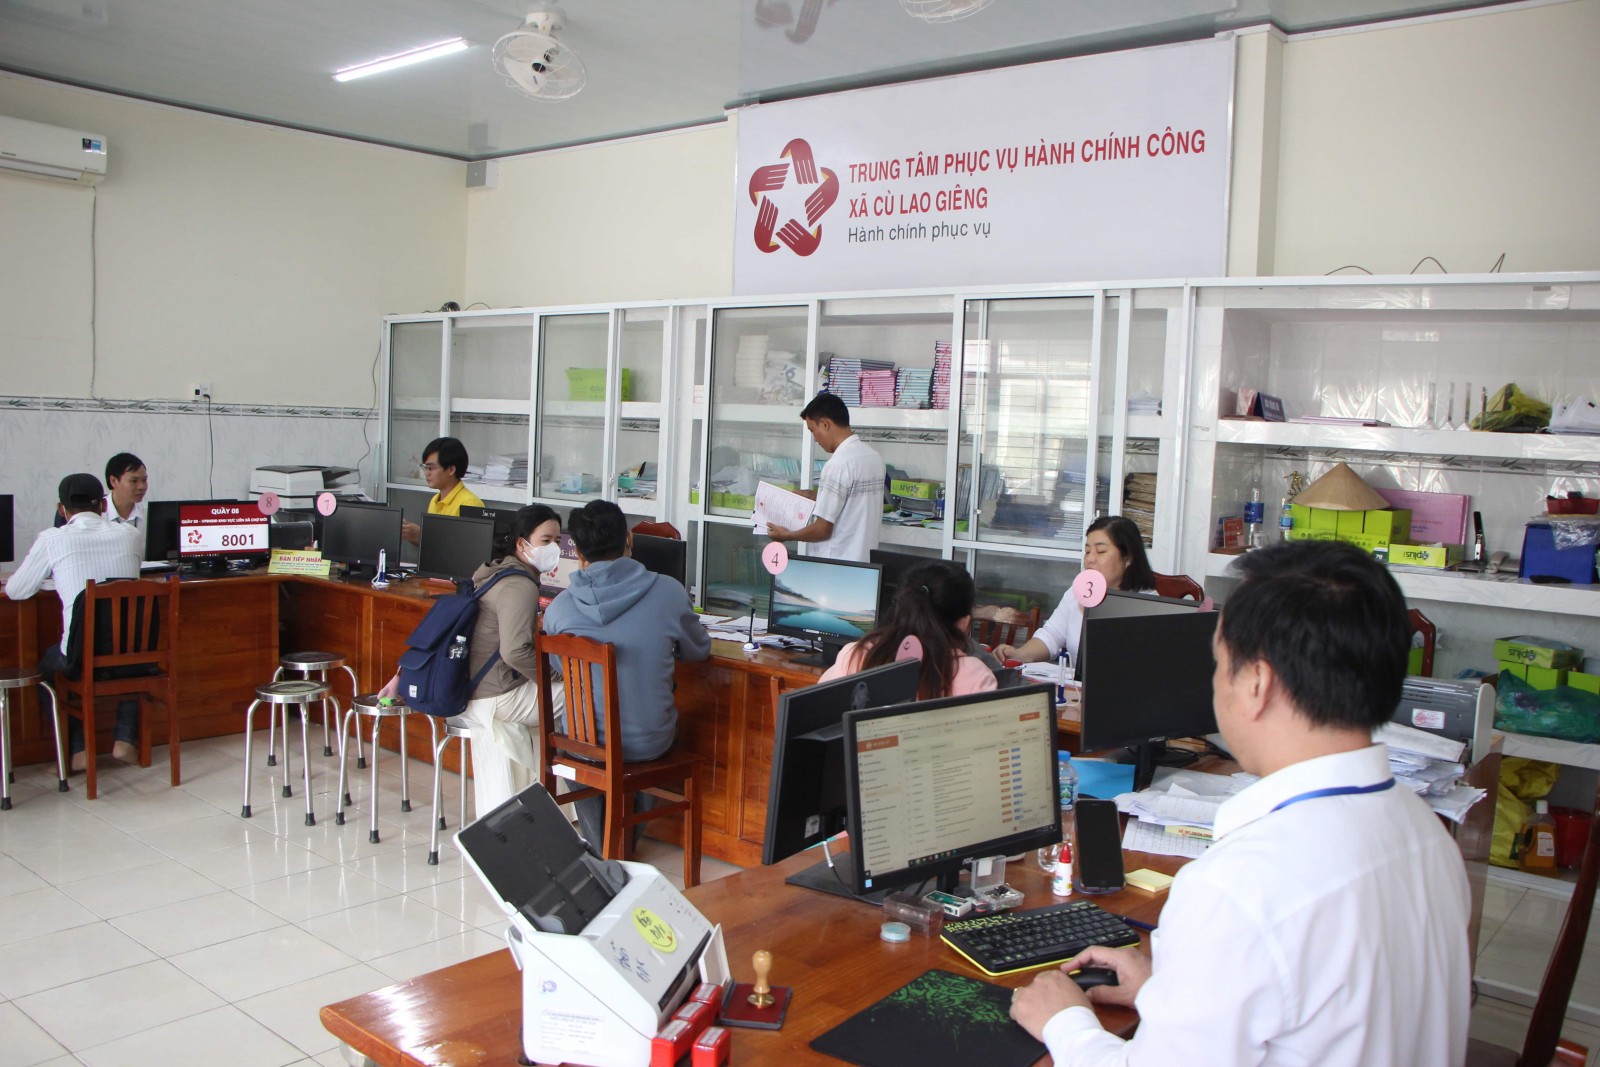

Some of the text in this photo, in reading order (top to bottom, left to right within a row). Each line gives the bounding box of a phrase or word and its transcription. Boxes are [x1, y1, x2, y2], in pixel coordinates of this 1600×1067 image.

[849, 125, 1206, 184] TRUNG TÂM PHỤC VỤ HÀNH CHÍNH CÔNG
[849, 183, 989, 219] XÃ CÙ LAO GIÊNG
[848, 220, 992, 243] Hành chính phục vụ
[211, 506, 231, 515] QUẦY
[265, 496, 273, 509] 8
[221, 533, 254, 547] 8001
[771, 552, 779, 568] 4
[1082, 581, 1094, 599] 3
